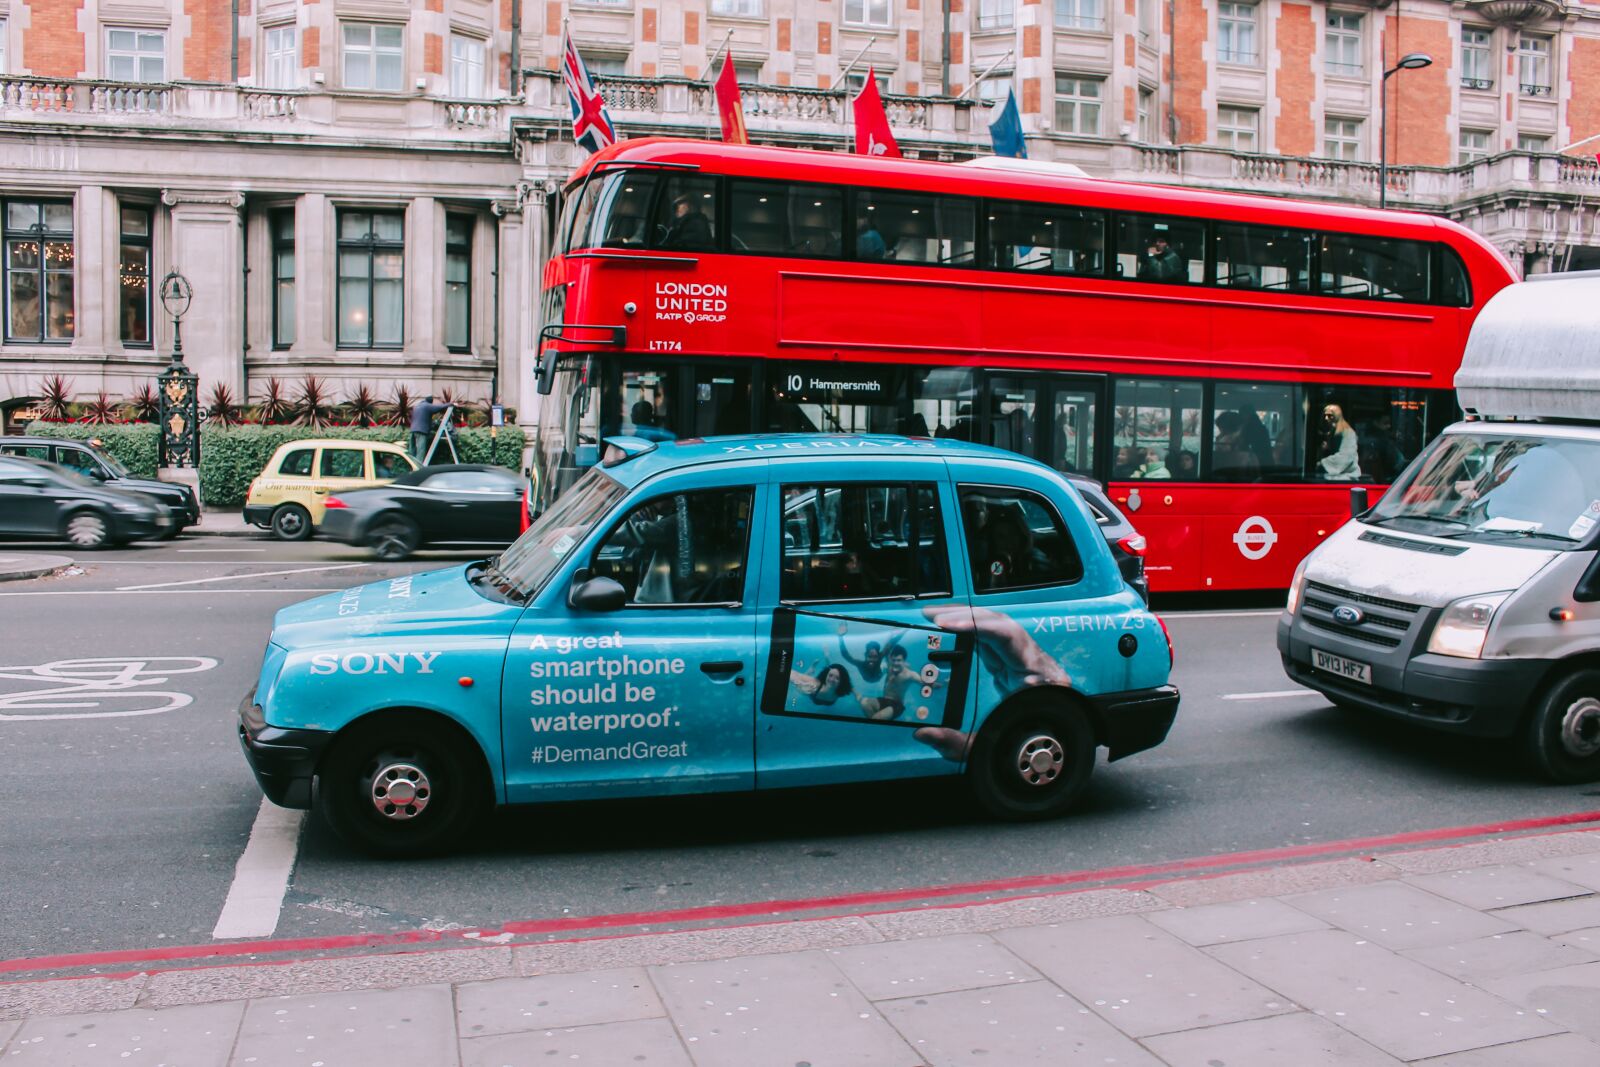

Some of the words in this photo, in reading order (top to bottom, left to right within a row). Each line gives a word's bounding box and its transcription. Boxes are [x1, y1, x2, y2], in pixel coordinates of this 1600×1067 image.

[656, 282, 727, 297] LONDON
[656, 297, 727, 312] UNITED
[656, 312, 682, 320] RATP
[696, 314, 727, 322] GROUP
[649, 340, 682, 351] LT174
[787, 374, 802, 392] 10
[809, 378, 881, 391] Hammersmith
[722, 440, 881, 453] XPERIA
[891, 441, 937, 449] Z3
[1032, 615, 1117, 634] XPERIA
[1121, 614, 1145, 630] Z3
[529, 634, 549, 650] A
[556, 631, 623, 654] great
[309, 651, 442, 675] SONY
[530, 655, 685, 681] smartphone
[1317, 652, 1341, 672] DY13
[1343, 660, 1365, 680] HFZ
[530, 682, 616, 705] should
[625, 682, 656, 702] be
[532, 741, 688, 764] #DemandGreat
